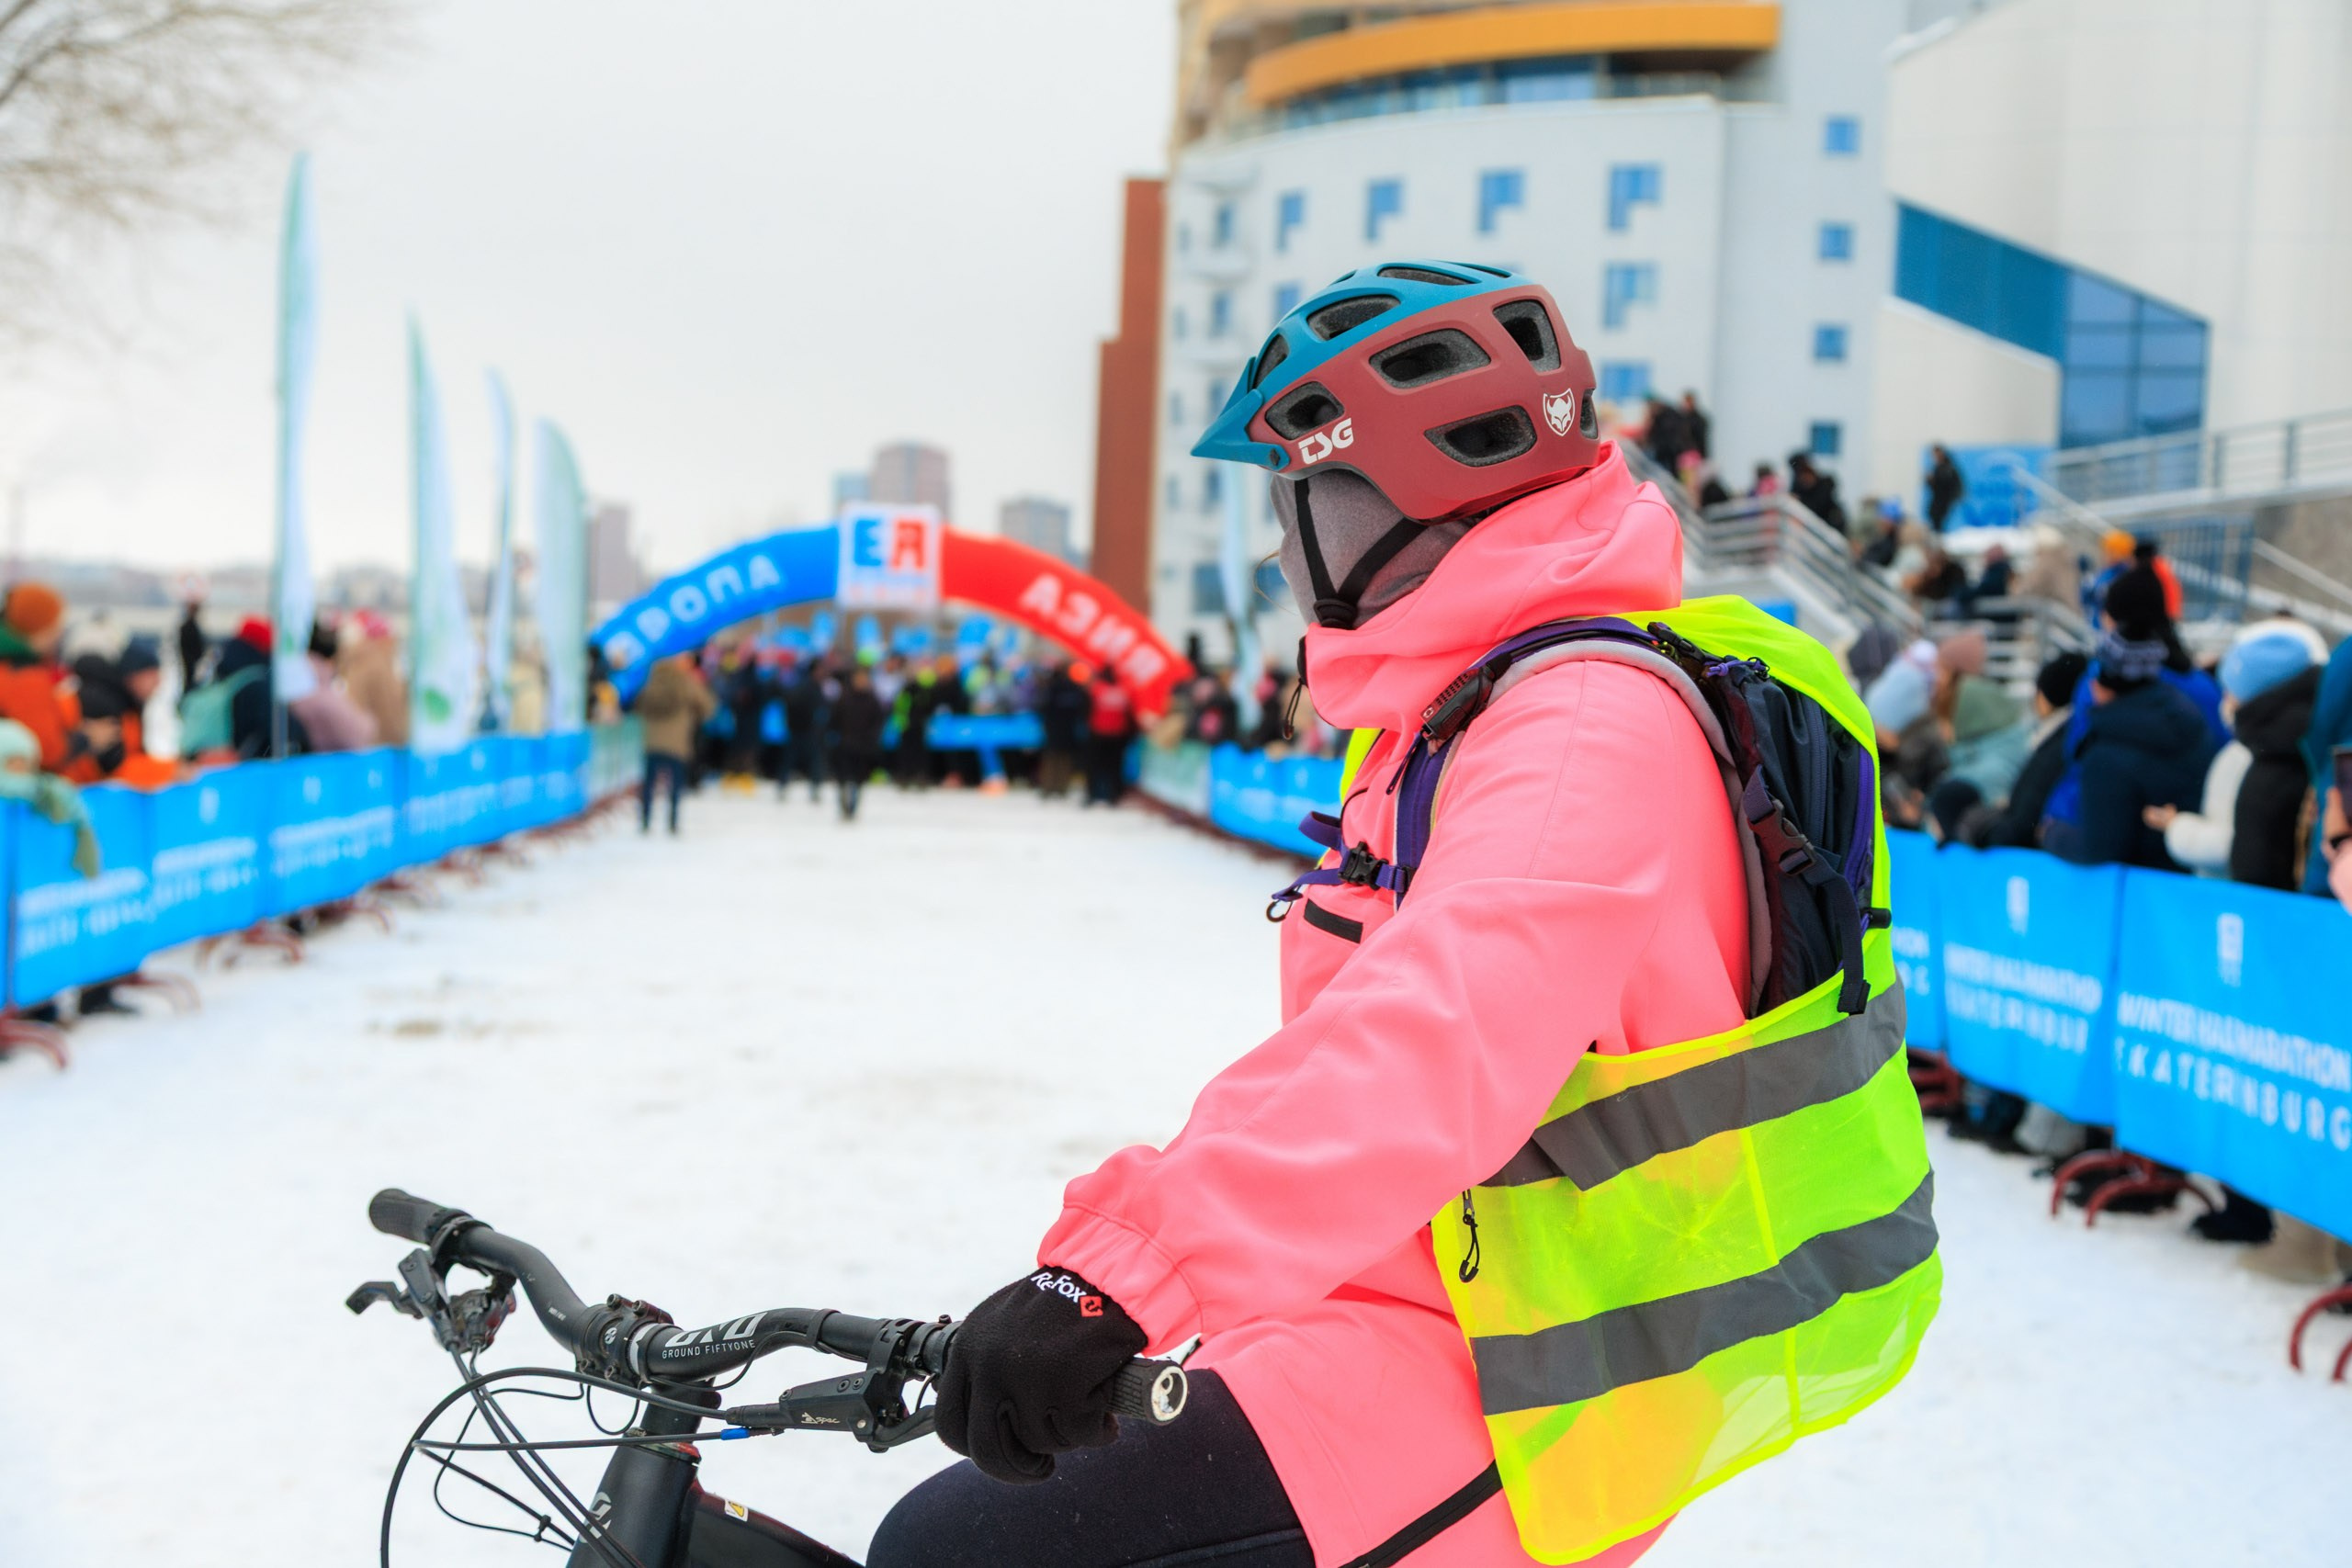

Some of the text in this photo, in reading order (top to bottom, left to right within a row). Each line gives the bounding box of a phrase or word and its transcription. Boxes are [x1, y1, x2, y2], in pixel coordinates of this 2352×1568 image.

[1298, 417, 1354, 464] TSG
[662, 1339, 756, 1359] GROUND FIFTYONE
